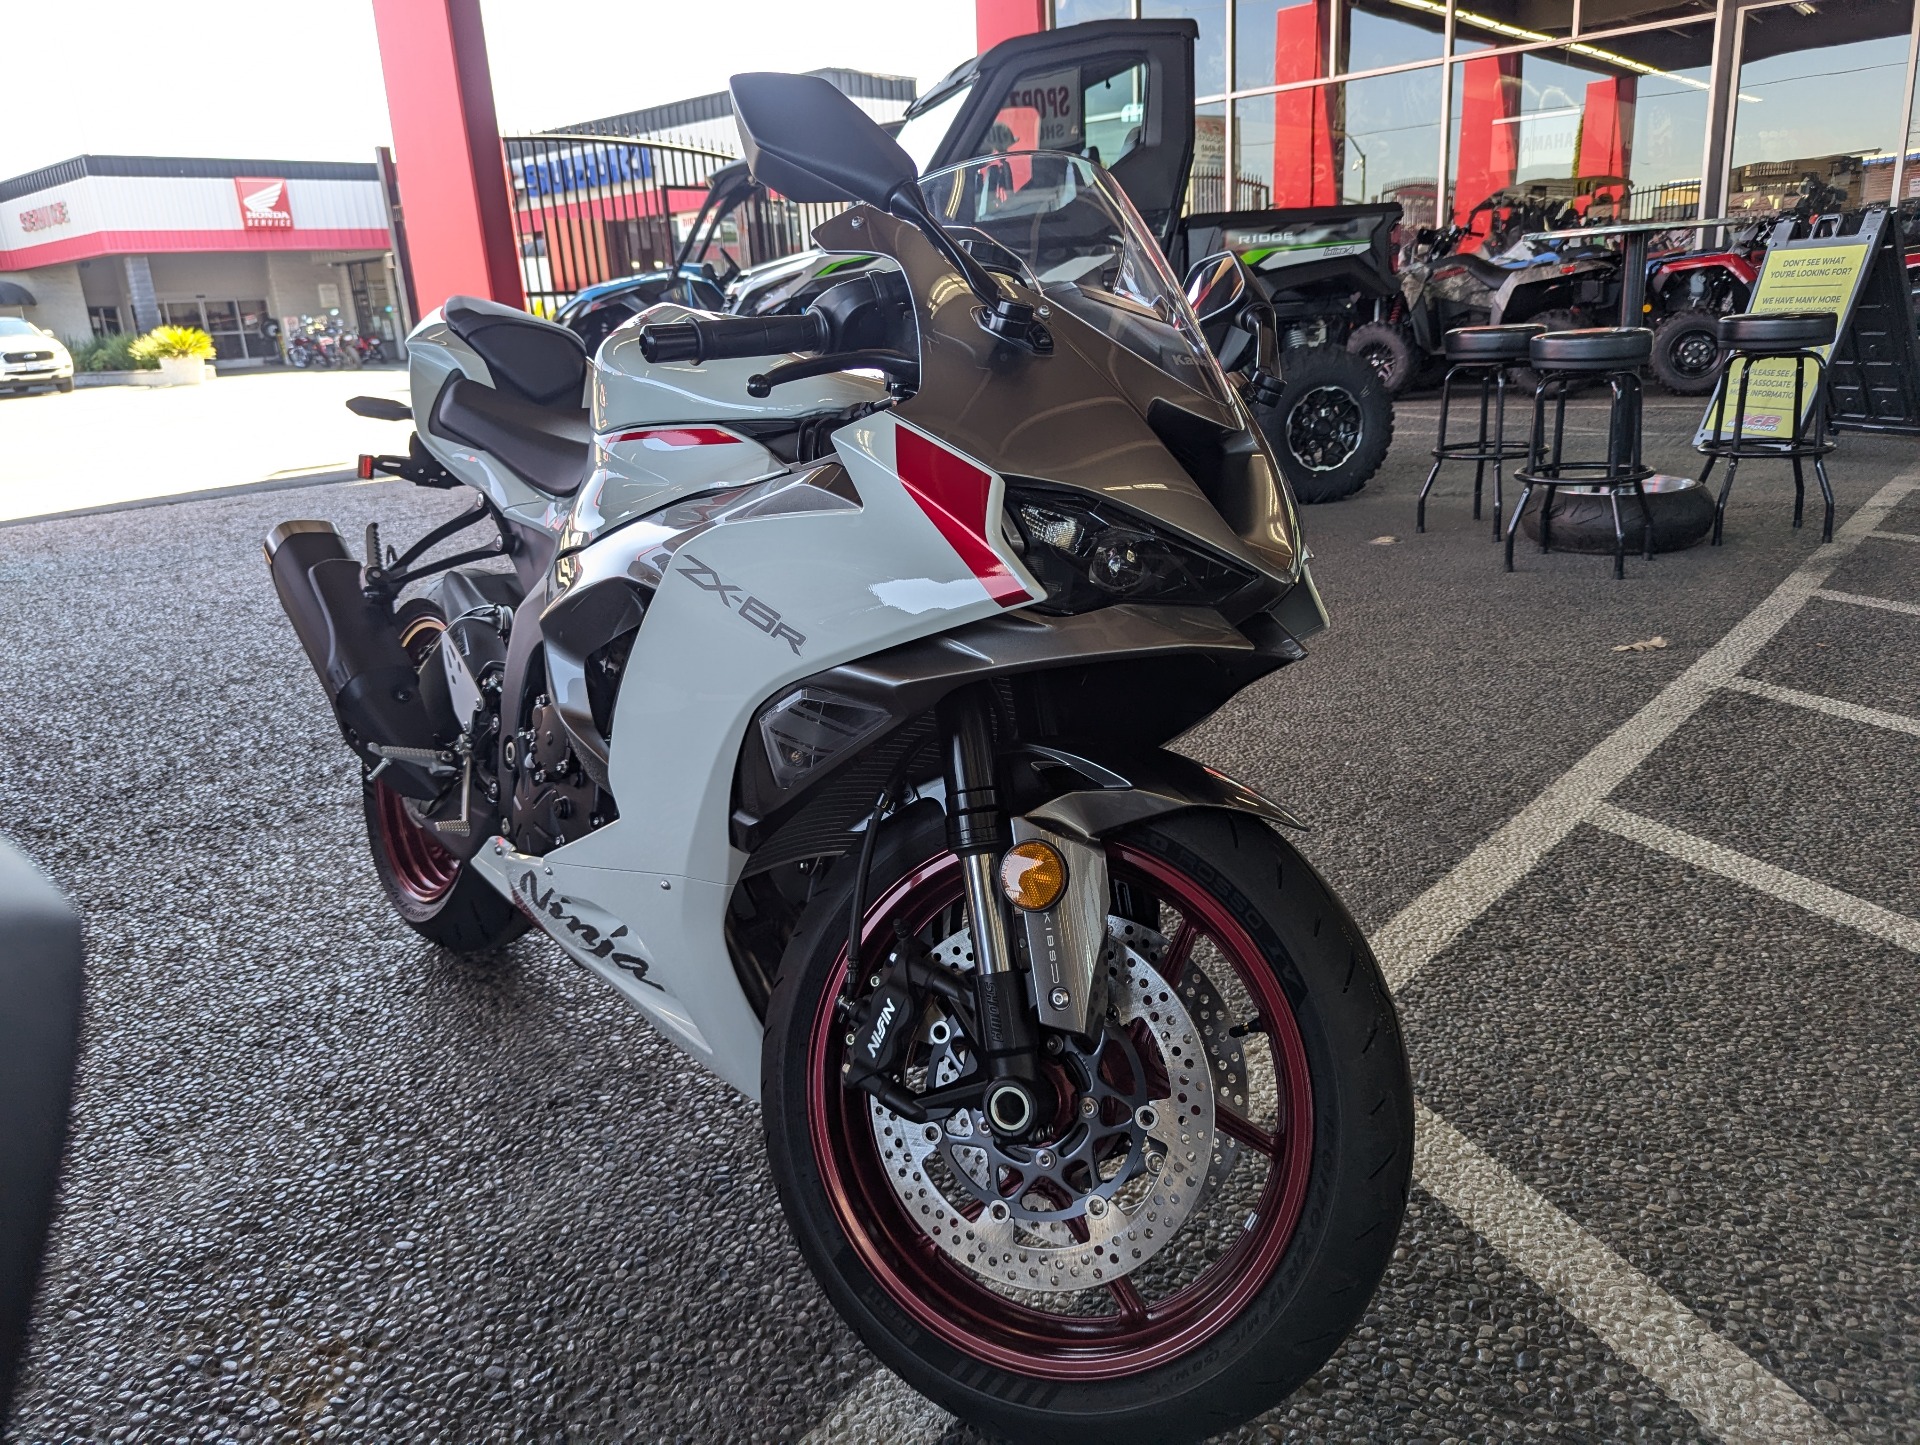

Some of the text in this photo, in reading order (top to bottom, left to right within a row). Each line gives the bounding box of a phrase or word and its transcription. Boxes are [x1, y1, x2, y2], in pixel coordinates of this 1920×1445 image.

[524, 146, 653, 197] SUZUKI
[246, 211, 290, 219] HONDA
[247, 218, 292, 227] SERVICE
[1238, 231, 1294, 244] RIDGE
[1783, 257, 1846, 267] DON'T SEE WHAT
[1770, 268, 1853, 278] YOU'RE LOOKING FOR?
[1774, 296, 1794, 304] HAVE
[1795, 296, 1818, 304] MANY
[1818, 295, 1841, 303] MORE
[1752, 380, 1791, 388] ASSOCIATE
[1750, 390, 1796, 399] INFORMATIO
[675, 554, 807, 657] ZX-6R
[519, 869, 666, 992] Ninja
[867, 998, 896, 1059] NISSIN
